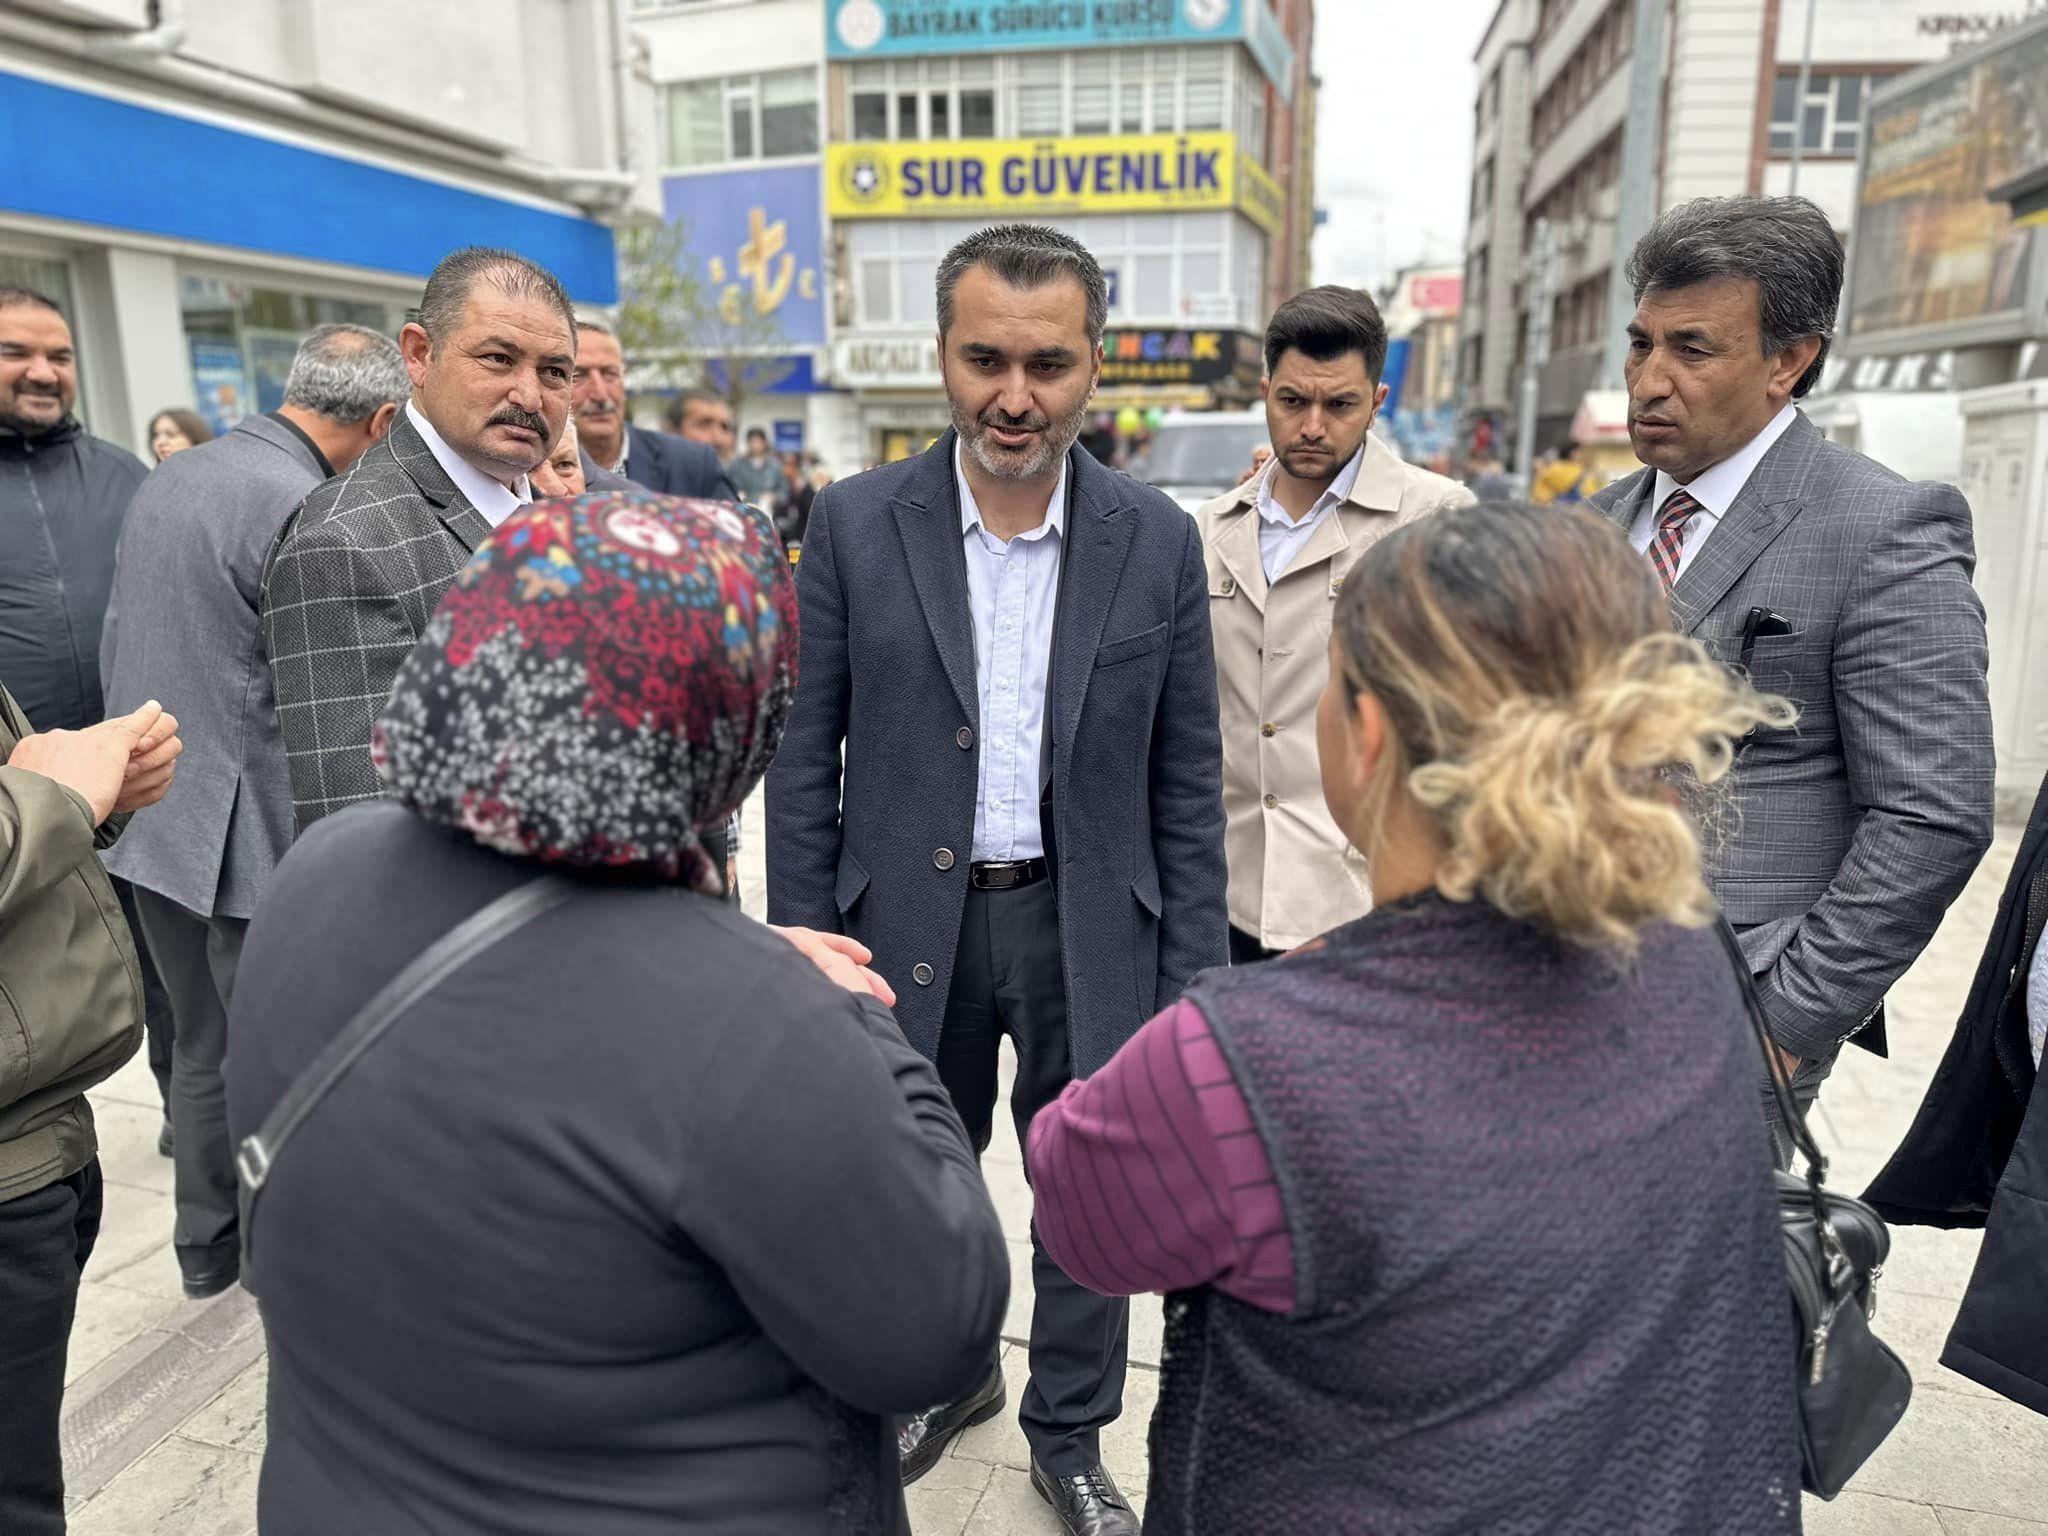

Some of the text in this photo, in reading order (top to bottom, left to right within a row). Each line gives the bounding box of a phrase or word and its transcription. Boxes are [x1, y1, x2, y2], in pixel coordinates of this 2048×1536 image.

[889, 11, 981, 38] BAYRAK
[902, 157, 984, 198] SUR
[1003, 138, 1220, 196] GÜVENLİK
